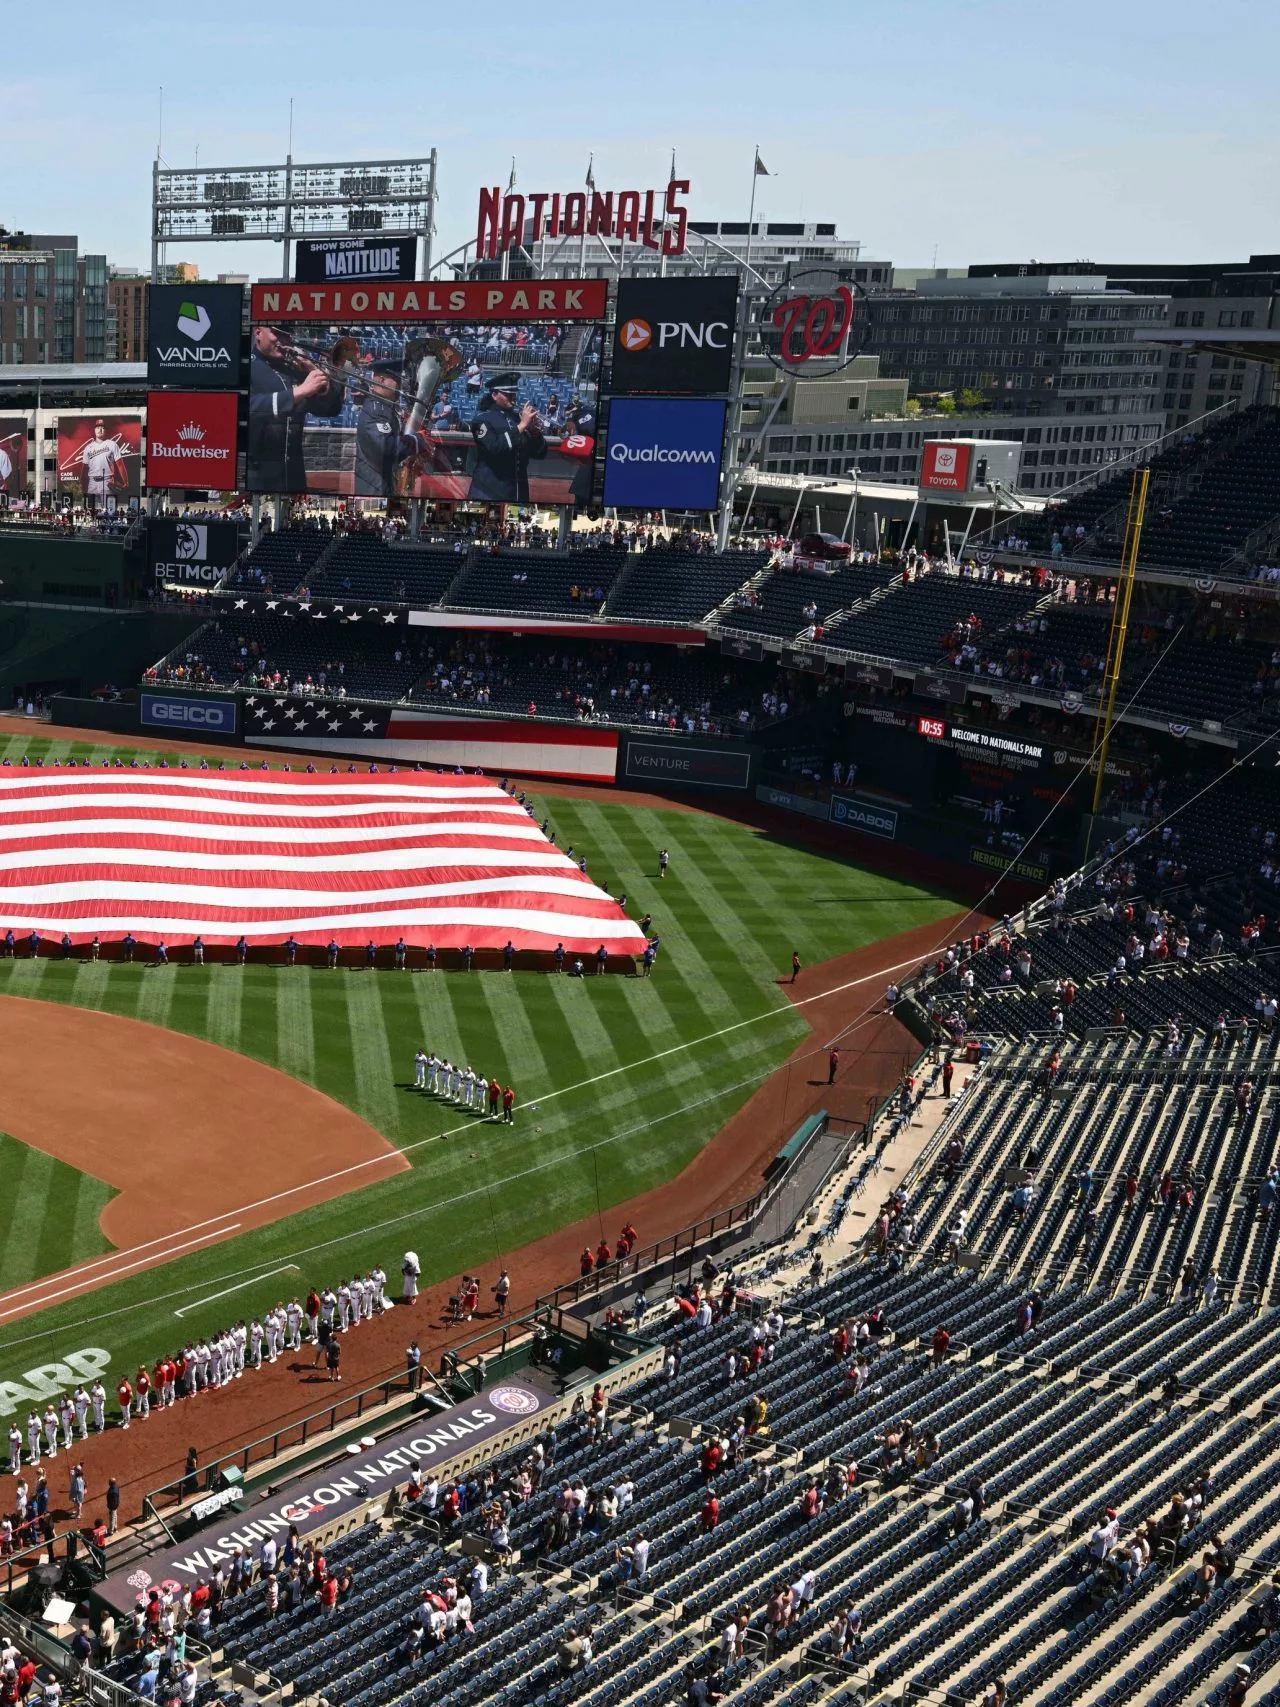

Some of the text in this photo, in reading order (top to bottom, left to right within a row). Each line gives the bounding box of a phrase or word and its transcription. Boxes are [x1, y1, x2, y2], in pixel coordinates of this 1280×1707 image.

[476, 180, 690, 259] NATIONALS
[310, 240, 365, 252] SHOW SOME
[325, 247, 401, 276] NATITUDE
[263, 289, 585, 312] NATIONALS PARK
[657, 322, 729, 349] PNC
[773, 286, 853, 364] W
[156, 347, 231, 362] VANDA
[151, 442, 230, 459] Budweiser
[610, 443, 716, 464] Qualcomm
[928, 477, 958, 486] TOYOTA
[155, 562, 228, 580] BETMGM
[152, 703, 224, 725] GEICO
[856, 706, 894, 718] WASHINGTON
[873, 715, 906, 727] NATIONALS
[920, 719, 943, 736] 10:55
[952, 728, 1042, 758] WELCOME TO NATIONALS PARK
[635, 755, 690, 771] VENTURE
[848, 808, 894, 830] DABOS
[972, 850, 1045, 879] HERCULES FENCE
[172, 1408, 496, 1576] WASHINGTON NATIONALS
